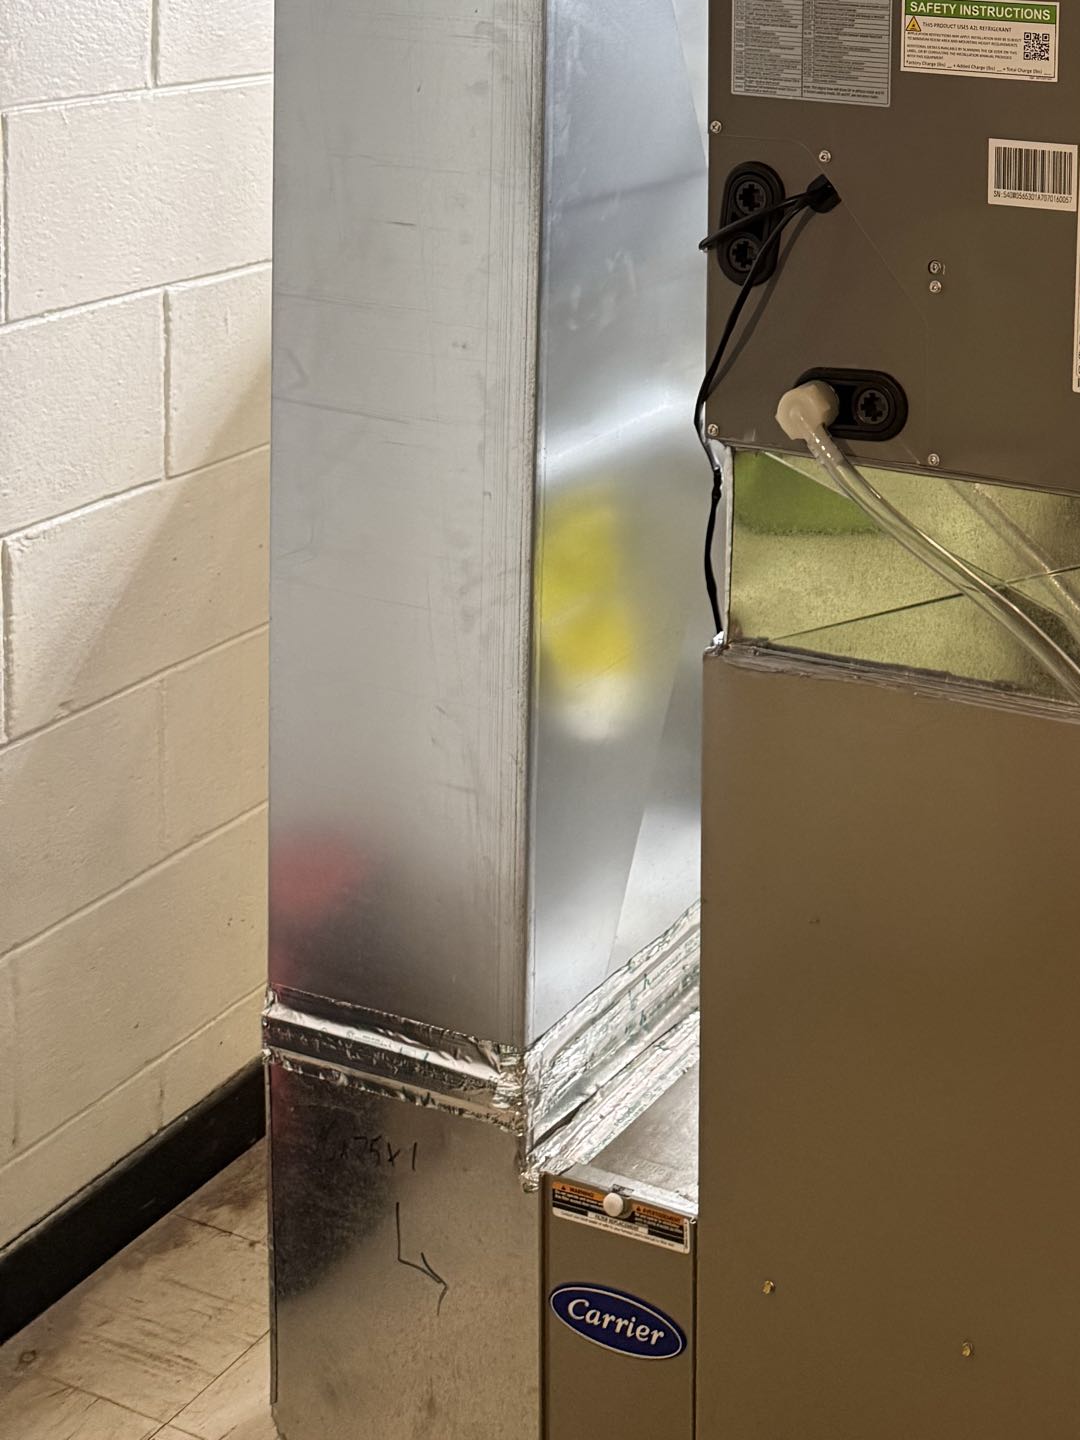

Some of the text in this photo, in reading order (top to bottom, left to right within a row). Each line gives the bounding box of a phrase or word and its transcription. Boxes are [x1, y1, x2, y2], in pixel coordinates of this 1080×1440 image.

[910, 2, 1050, 20] SAFETY INSTRUCTIONS
[568, 1299, 665, 1345] Carrier
